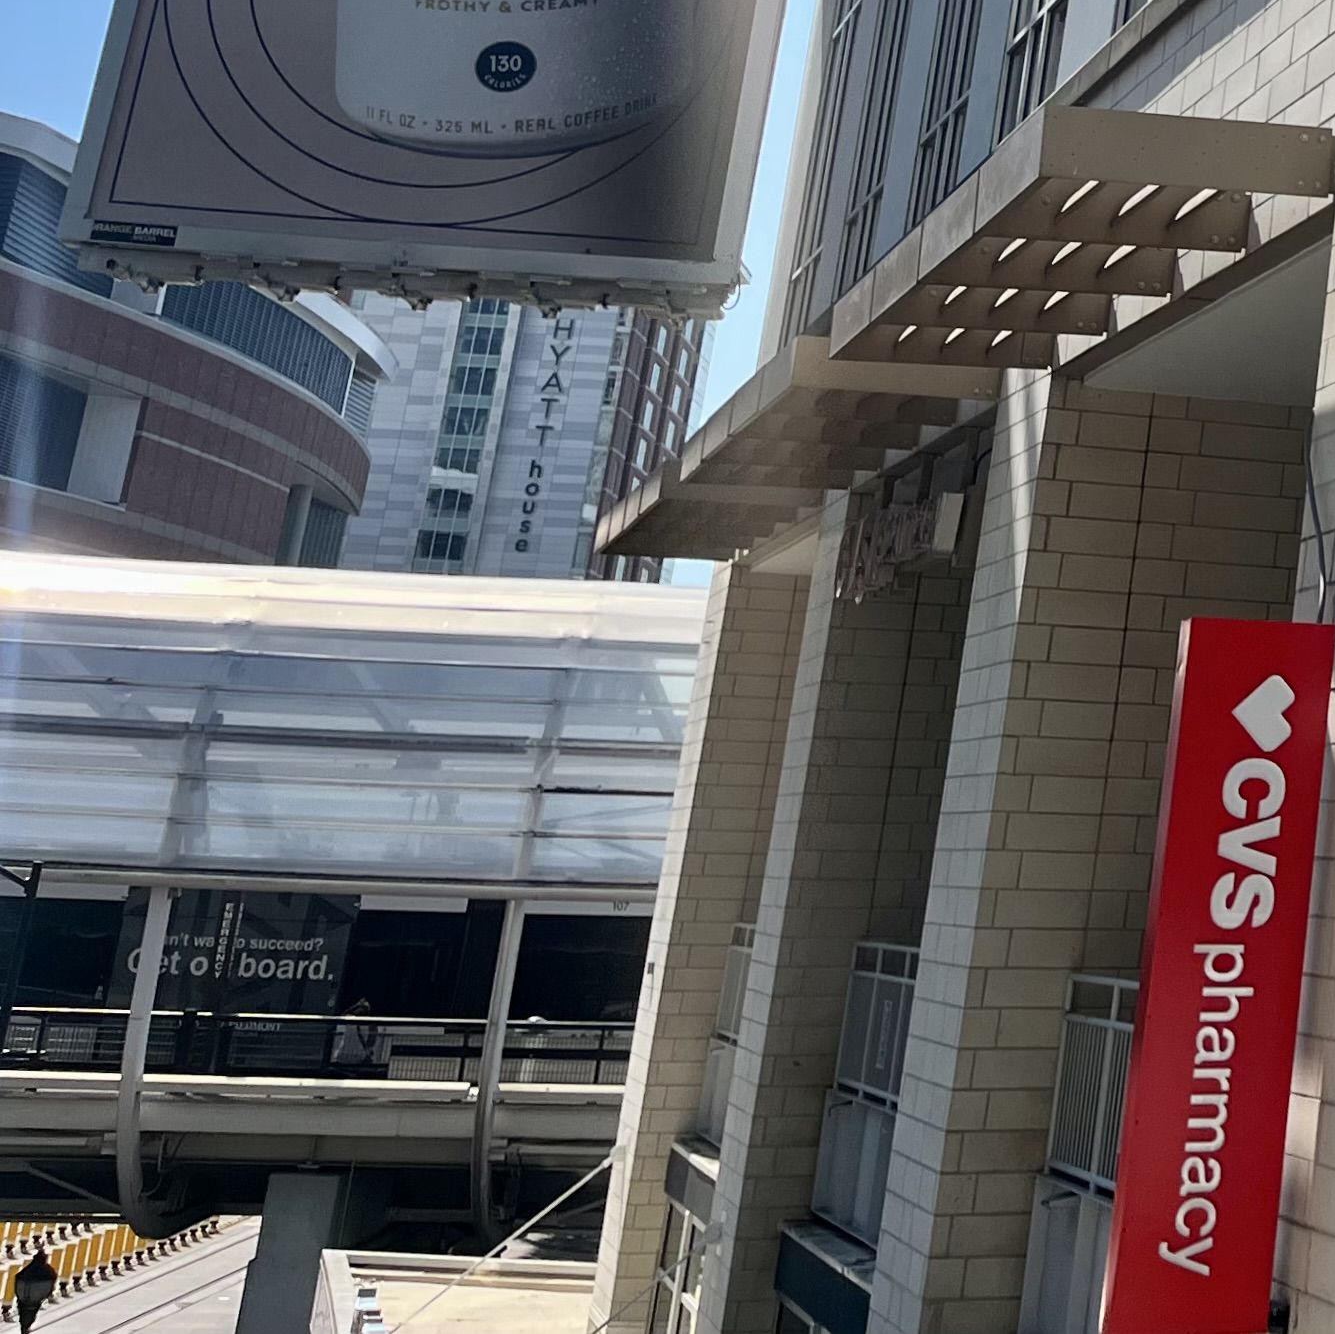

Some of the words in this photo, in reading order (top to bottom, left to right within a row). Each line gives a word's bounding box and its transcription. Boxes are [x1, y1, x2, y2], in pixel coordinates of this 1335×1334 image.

[499, 0, 512, 13] &
[489, 54, 522, 72] 130
[378, 109, 393, 124] FL
[399, 113, 416, 129] OZ
[435, 117, 463, 132] 325
[471, 119, 494, 134] ML
[515, 115, 557, 133] REAL
[564, 106, 619, 128] COFFEE
[535, 318, 576, 446] HYATT
[515, 459, 544, 552] house
[1209, 757, 1287, 930] CVS
[613, 899, 630, 912] 107
[250, 937, 325, 952] succeed?
[237, 952, 334, 981] board.
[1158, 943, 1255, 1277] pharmacy
